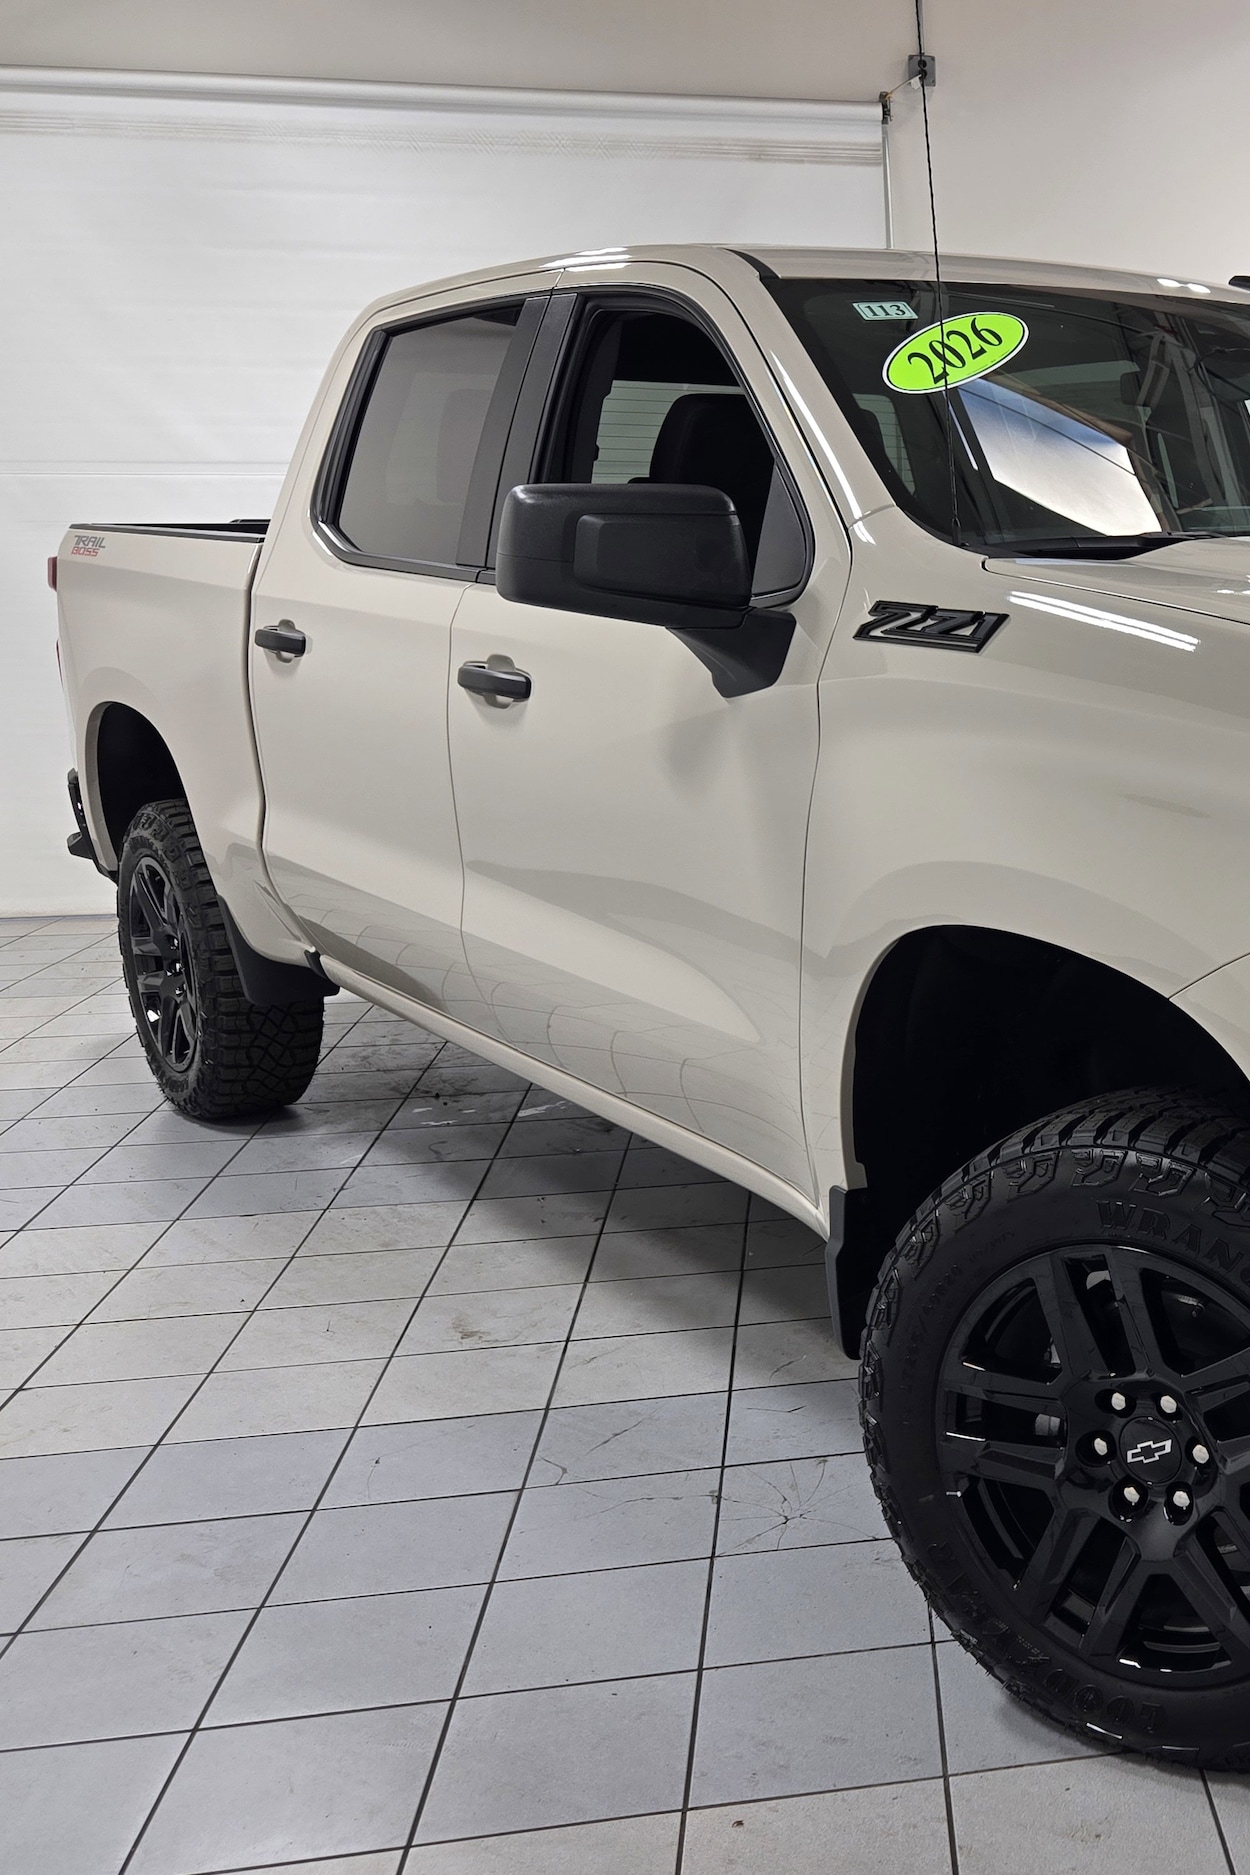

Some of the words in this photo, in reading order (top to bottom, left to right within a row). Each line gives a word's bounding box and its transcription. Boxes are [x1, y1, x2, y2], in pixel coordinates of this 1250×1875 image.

[864, 304, 906, 316] 113
[907, 317, 993, 384] 2026
[74, 535, 106, 548] TRAIL
[72, 546, 100, 557] BOSS
[852, 600, 1010, 653] Z71
